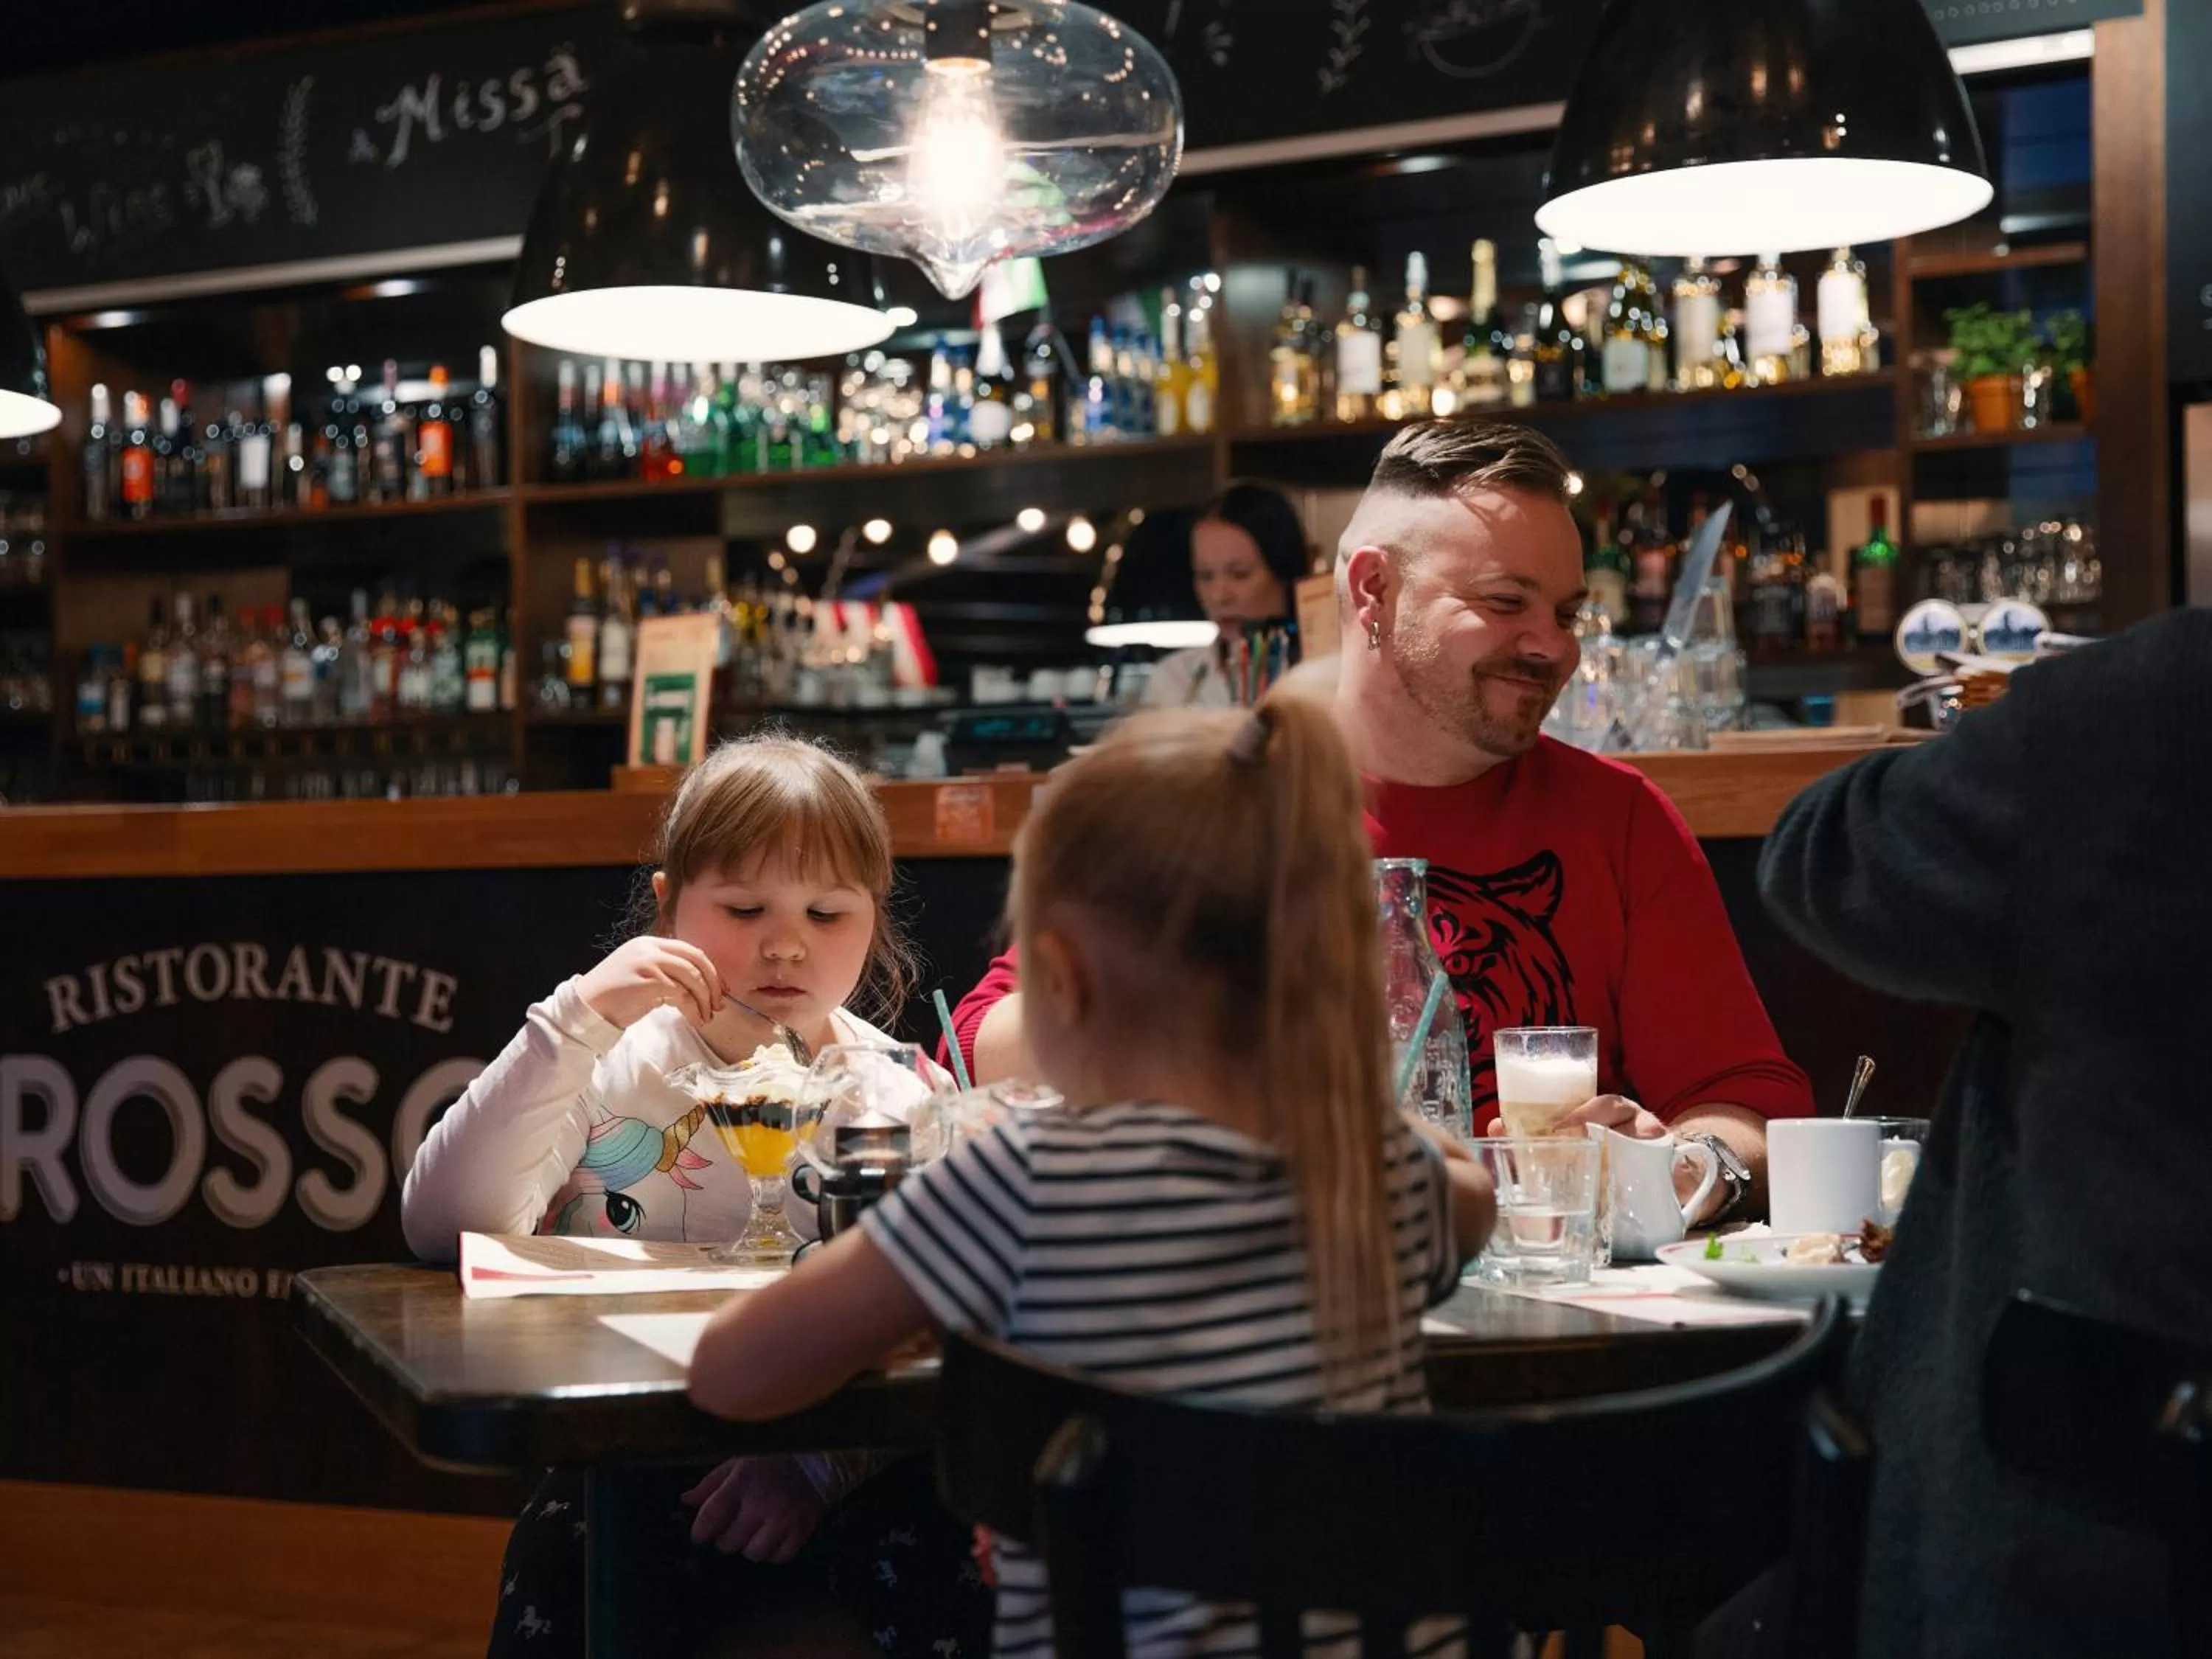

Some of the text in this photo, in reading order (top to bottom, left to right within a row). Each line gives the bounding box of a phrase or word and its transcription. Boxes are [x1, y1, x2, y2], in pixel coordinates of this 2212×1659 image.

[44, 942, 459, 1033] RISTORANTE
[72, 1260, 115, 1291] UN
[122, 1263, 260, 1298] ITALIANO
